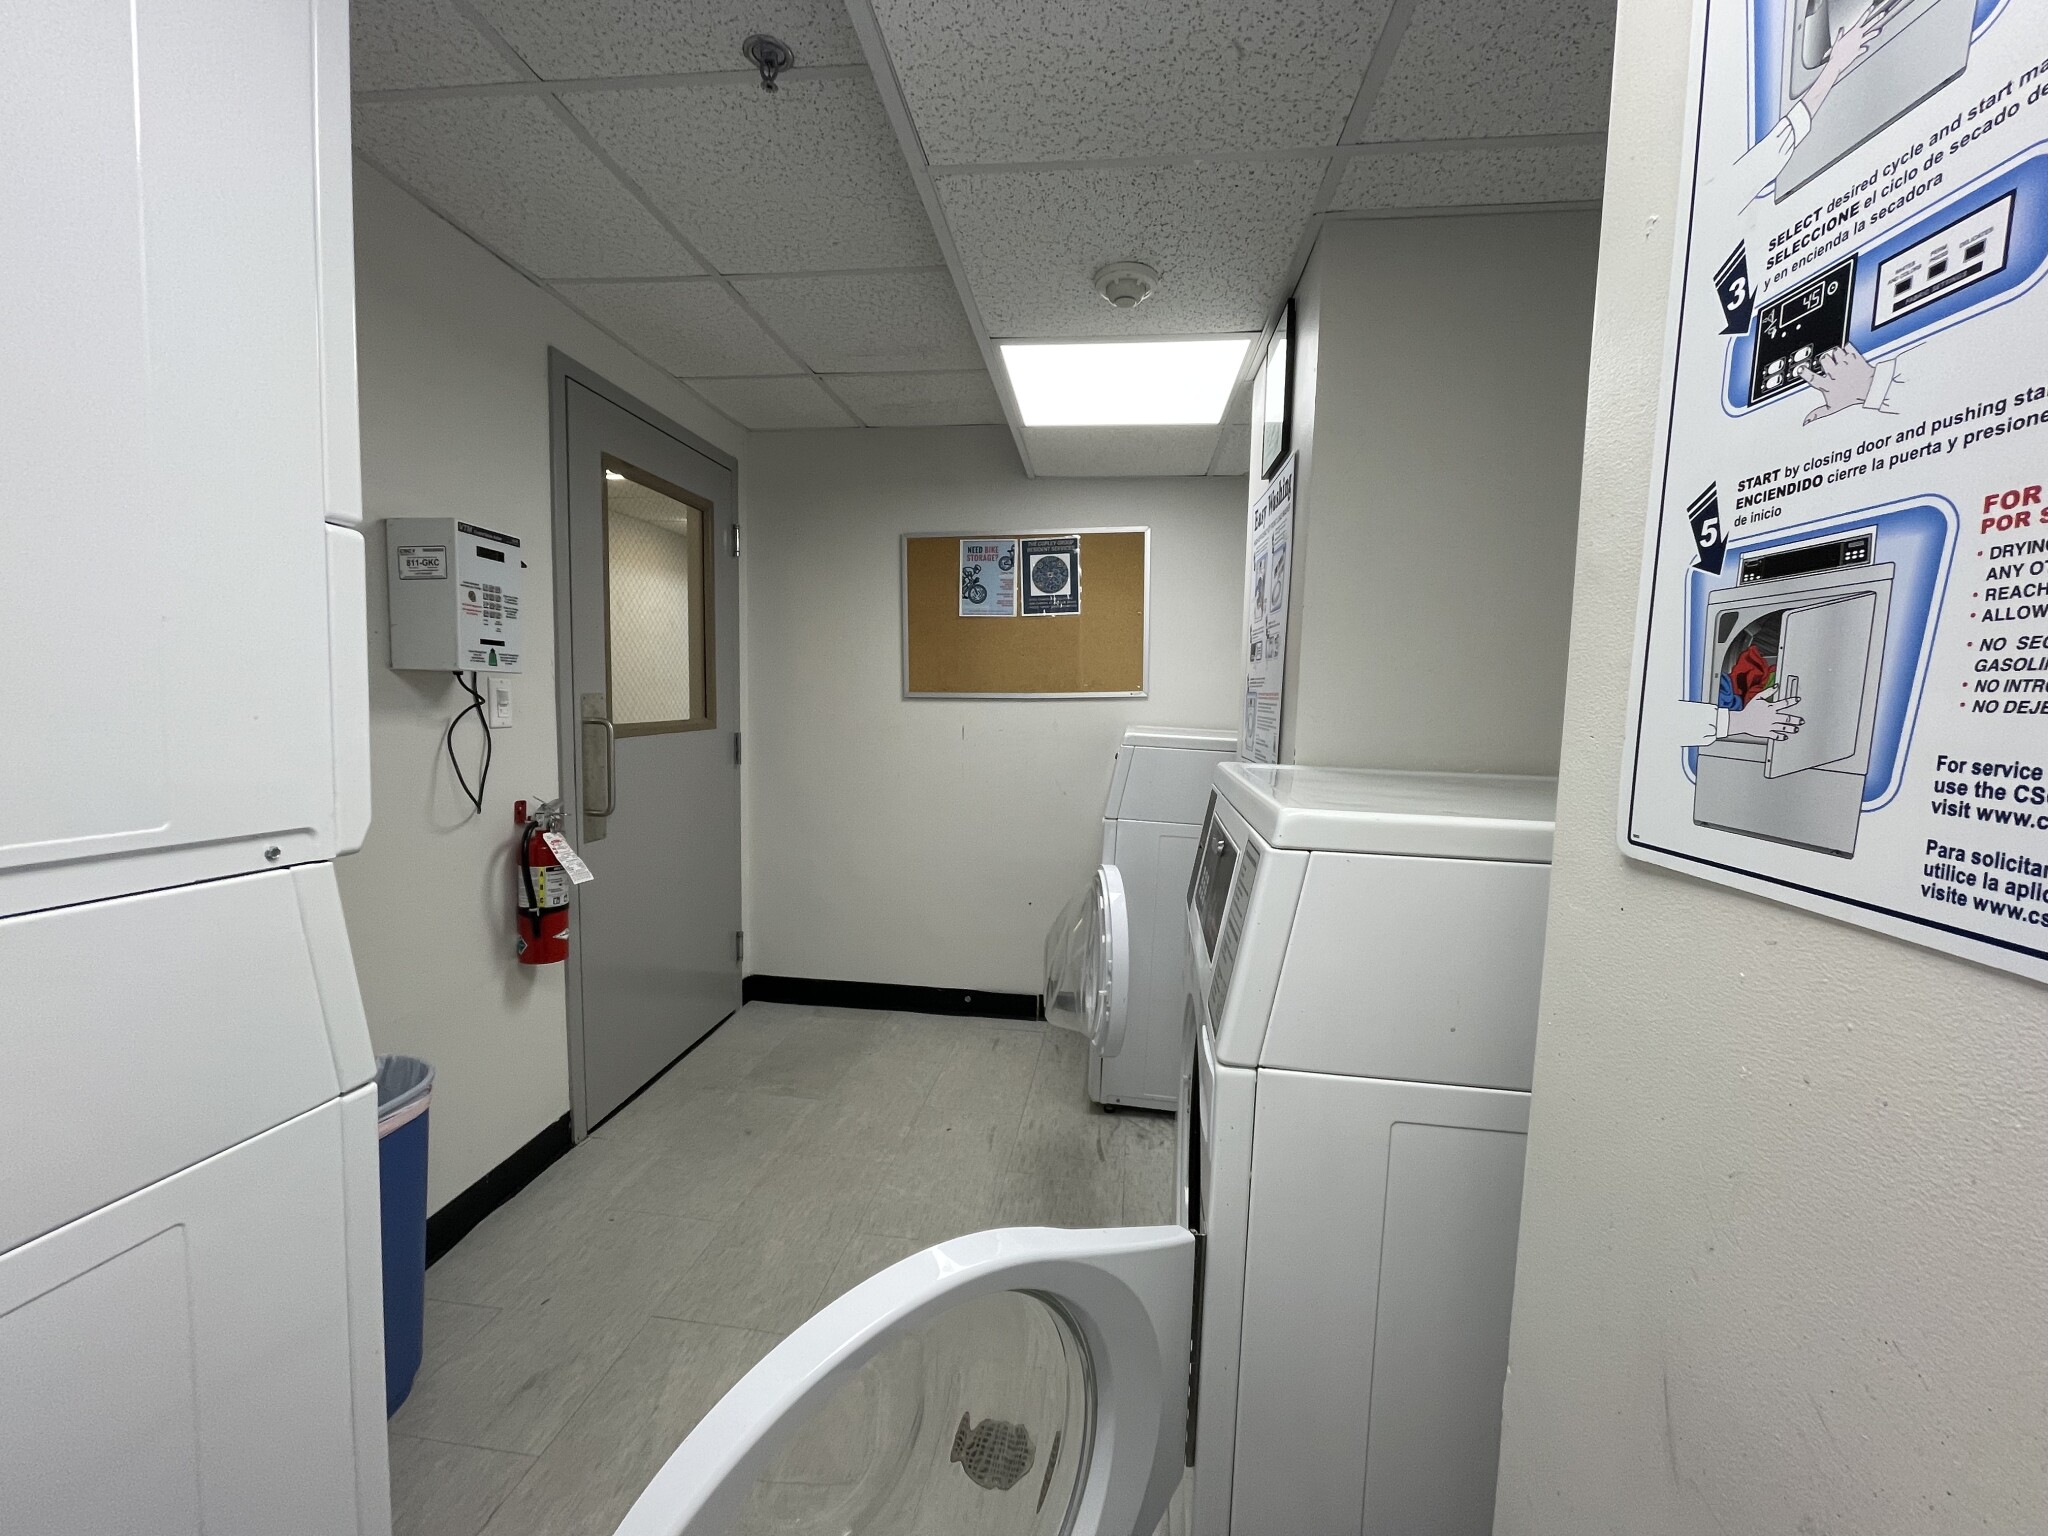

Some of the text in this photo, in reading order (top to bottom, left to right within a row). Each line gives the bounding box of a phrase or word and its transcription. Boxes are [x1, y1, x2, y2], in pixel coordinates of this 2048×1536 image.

[1768, 206, 1823, 252] SELECT
[1826, 169, 1879, 213] desired
[1882, 143, 1924, 177] cycle
[1928, 112, 1963, 147] and
[1967, 80, 2013, 121] start
[1766, 200, 1861, 271] SELECCIONE
[1863, 190, 1877, 209] el
[1881, 167, 1918, 198] ciclo
[1923, 150, 1944, 172] de
[1949, 102, 2020, 155] secado
[1763, 172, 1943, 292] y en encienda la secadora
[1726, 276, 1746, 311] 3
[1802, 288, 1821, 310] 45
[1737, 386, 2048, 493] START by closing door and pushing sta
[1735, 409, 2048, 510] ENCIENDIDO cierre la puerta y presione
[1254, 505, 1267, 531] Easy
[1268, 473, 1292, 516] Washing
[1983, 484, 2042, 515] FOR
[1733, 505, 1782, 527] de inicio
[1980, 510, 2031, 535] POR
[1699, 517, 1718, 548] 5
[967, 546, 983, 554] NEED
[967, 554, 999, 562] STORAGE?
[1989, 538, 2048, 560] DRYIN
[406, 558, 440, 567] 811-GKC
[1985, 560, 2048, 582] ANY O
[1985, 582, 2048, 602] REACH
[1981, 603, 2048, 623] ALLOW
[1979, 637, 2007, 652] NO
[1973, 678, 2048, 693] NO INTR
[1971, 699, 1999, 714] NO
[1936, 754, 2044, 781] For service
[1933, 780, 2048, 806] use the CS
[1931, 798, 2048, 830] visit www.c
[1925, 838, 2048, 879] Para solicitar
[1923, 863, 1977, 887] utilice
[1982, 871, 1999, 892] la
[1921, 882, 1968, 907] visite
